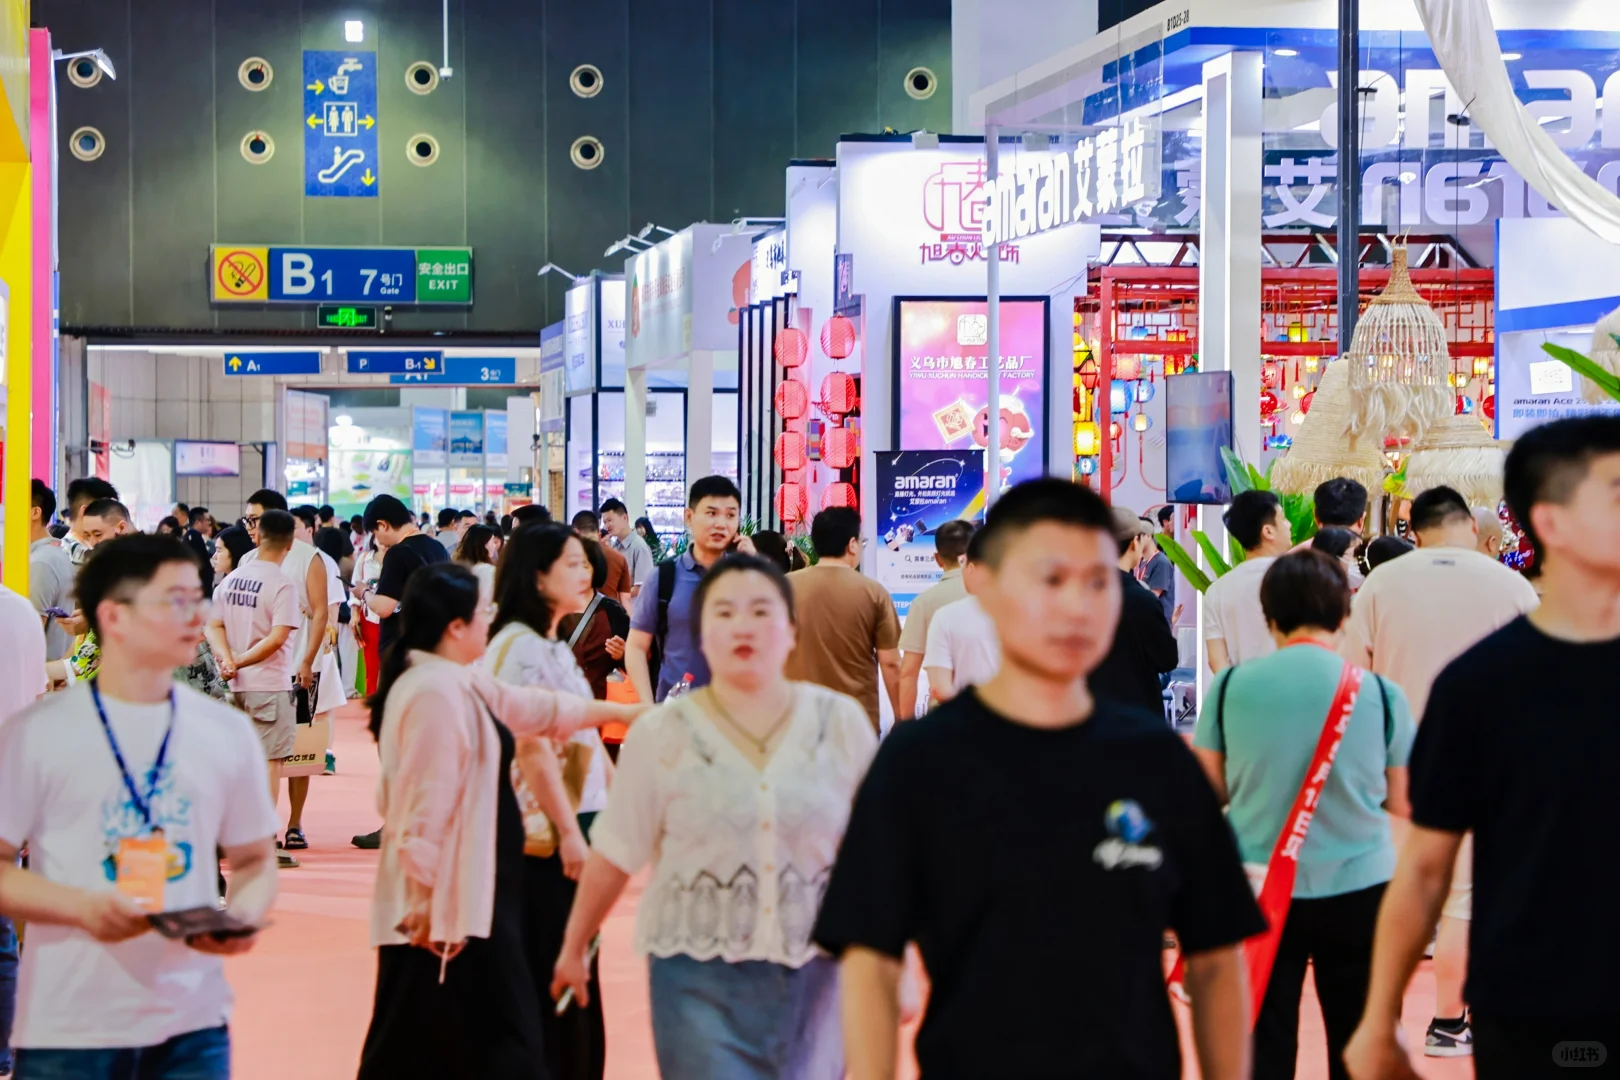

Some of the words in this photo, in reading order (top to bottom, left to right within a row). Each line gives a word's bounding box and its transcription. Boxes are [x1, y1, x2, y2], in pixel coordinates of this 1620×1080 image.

[1320, 70, 1620, 149] ama
[982, 152, 1069, 248] amaran
[419, 262, 469, 276] 安全出口
[380, 287, 400, 295] Gate
[428, 280, 459, 290] EXIT
[359, 358, 368, 369] P
[1513, 397, 1550, 405] amaran
[1553, 397, 1573, 405] Ace
[894, 475, 956, 489] amaran
